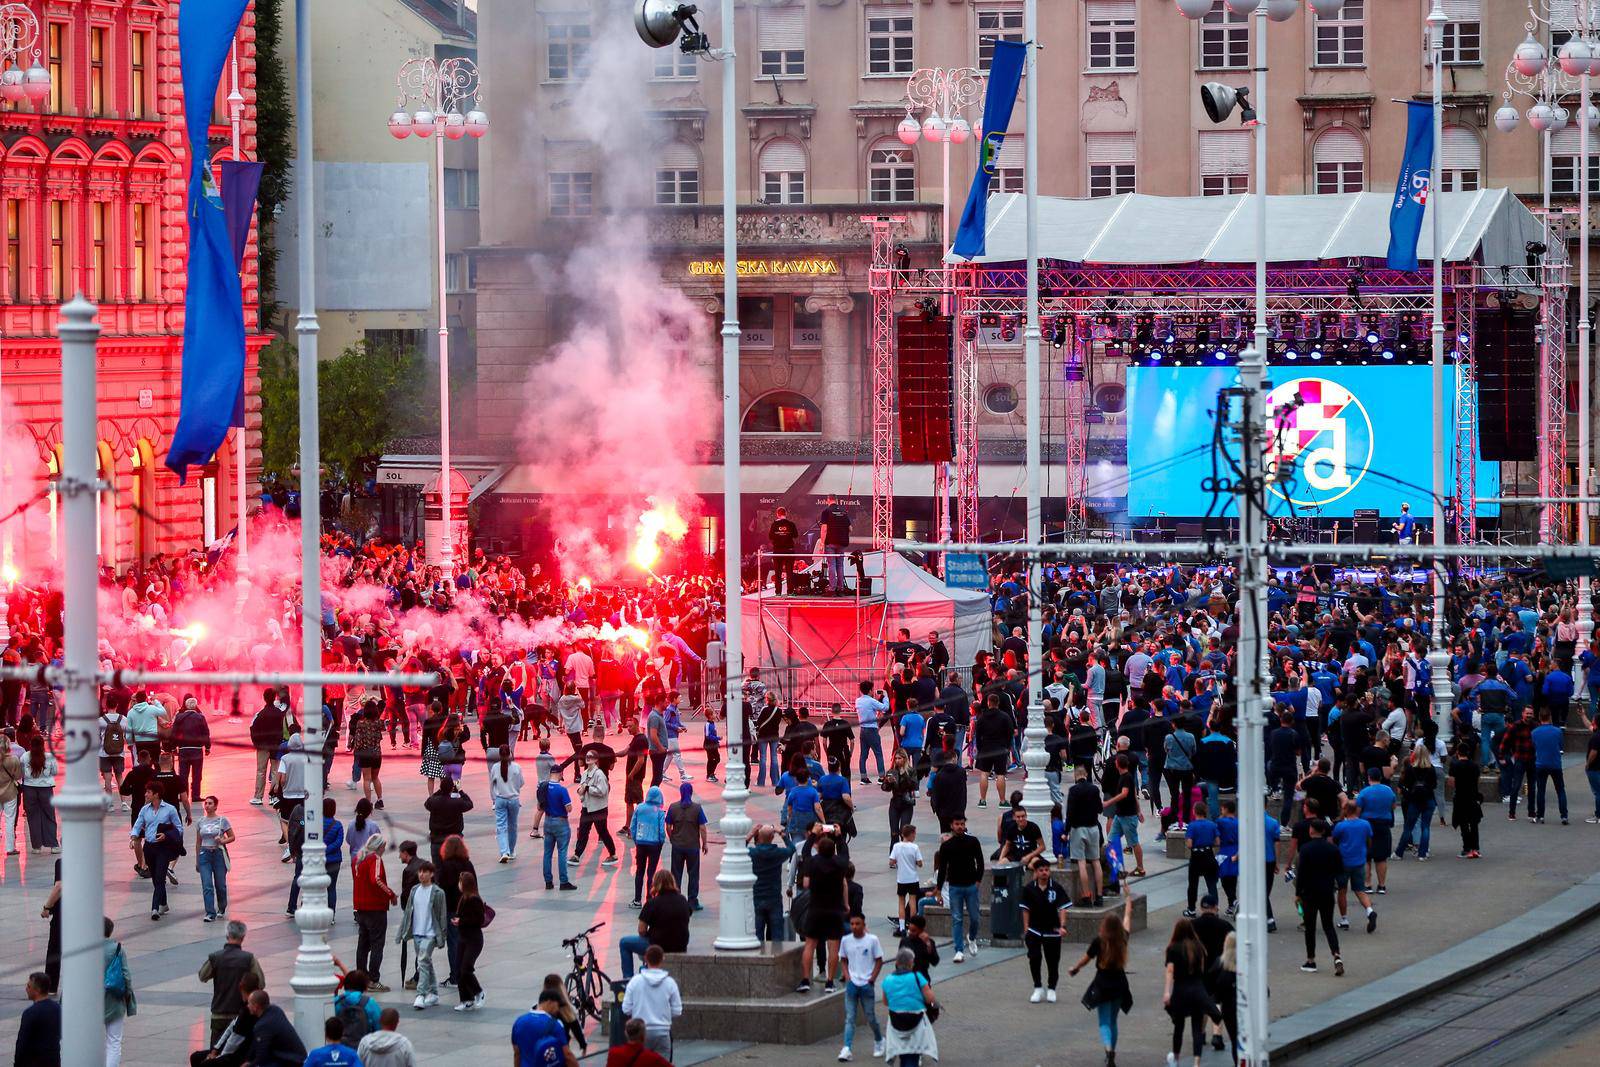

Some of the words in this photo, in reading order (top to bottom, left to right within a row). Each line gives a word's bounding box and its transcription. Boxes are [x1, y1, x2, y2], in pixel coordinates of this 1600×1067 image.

[688, 261, 768, 275] GRASKA
[771, 259, 837, 274] KAVANA
[746, 333, 765, 342] SOL
[801, 333, 821, 341] SOL
